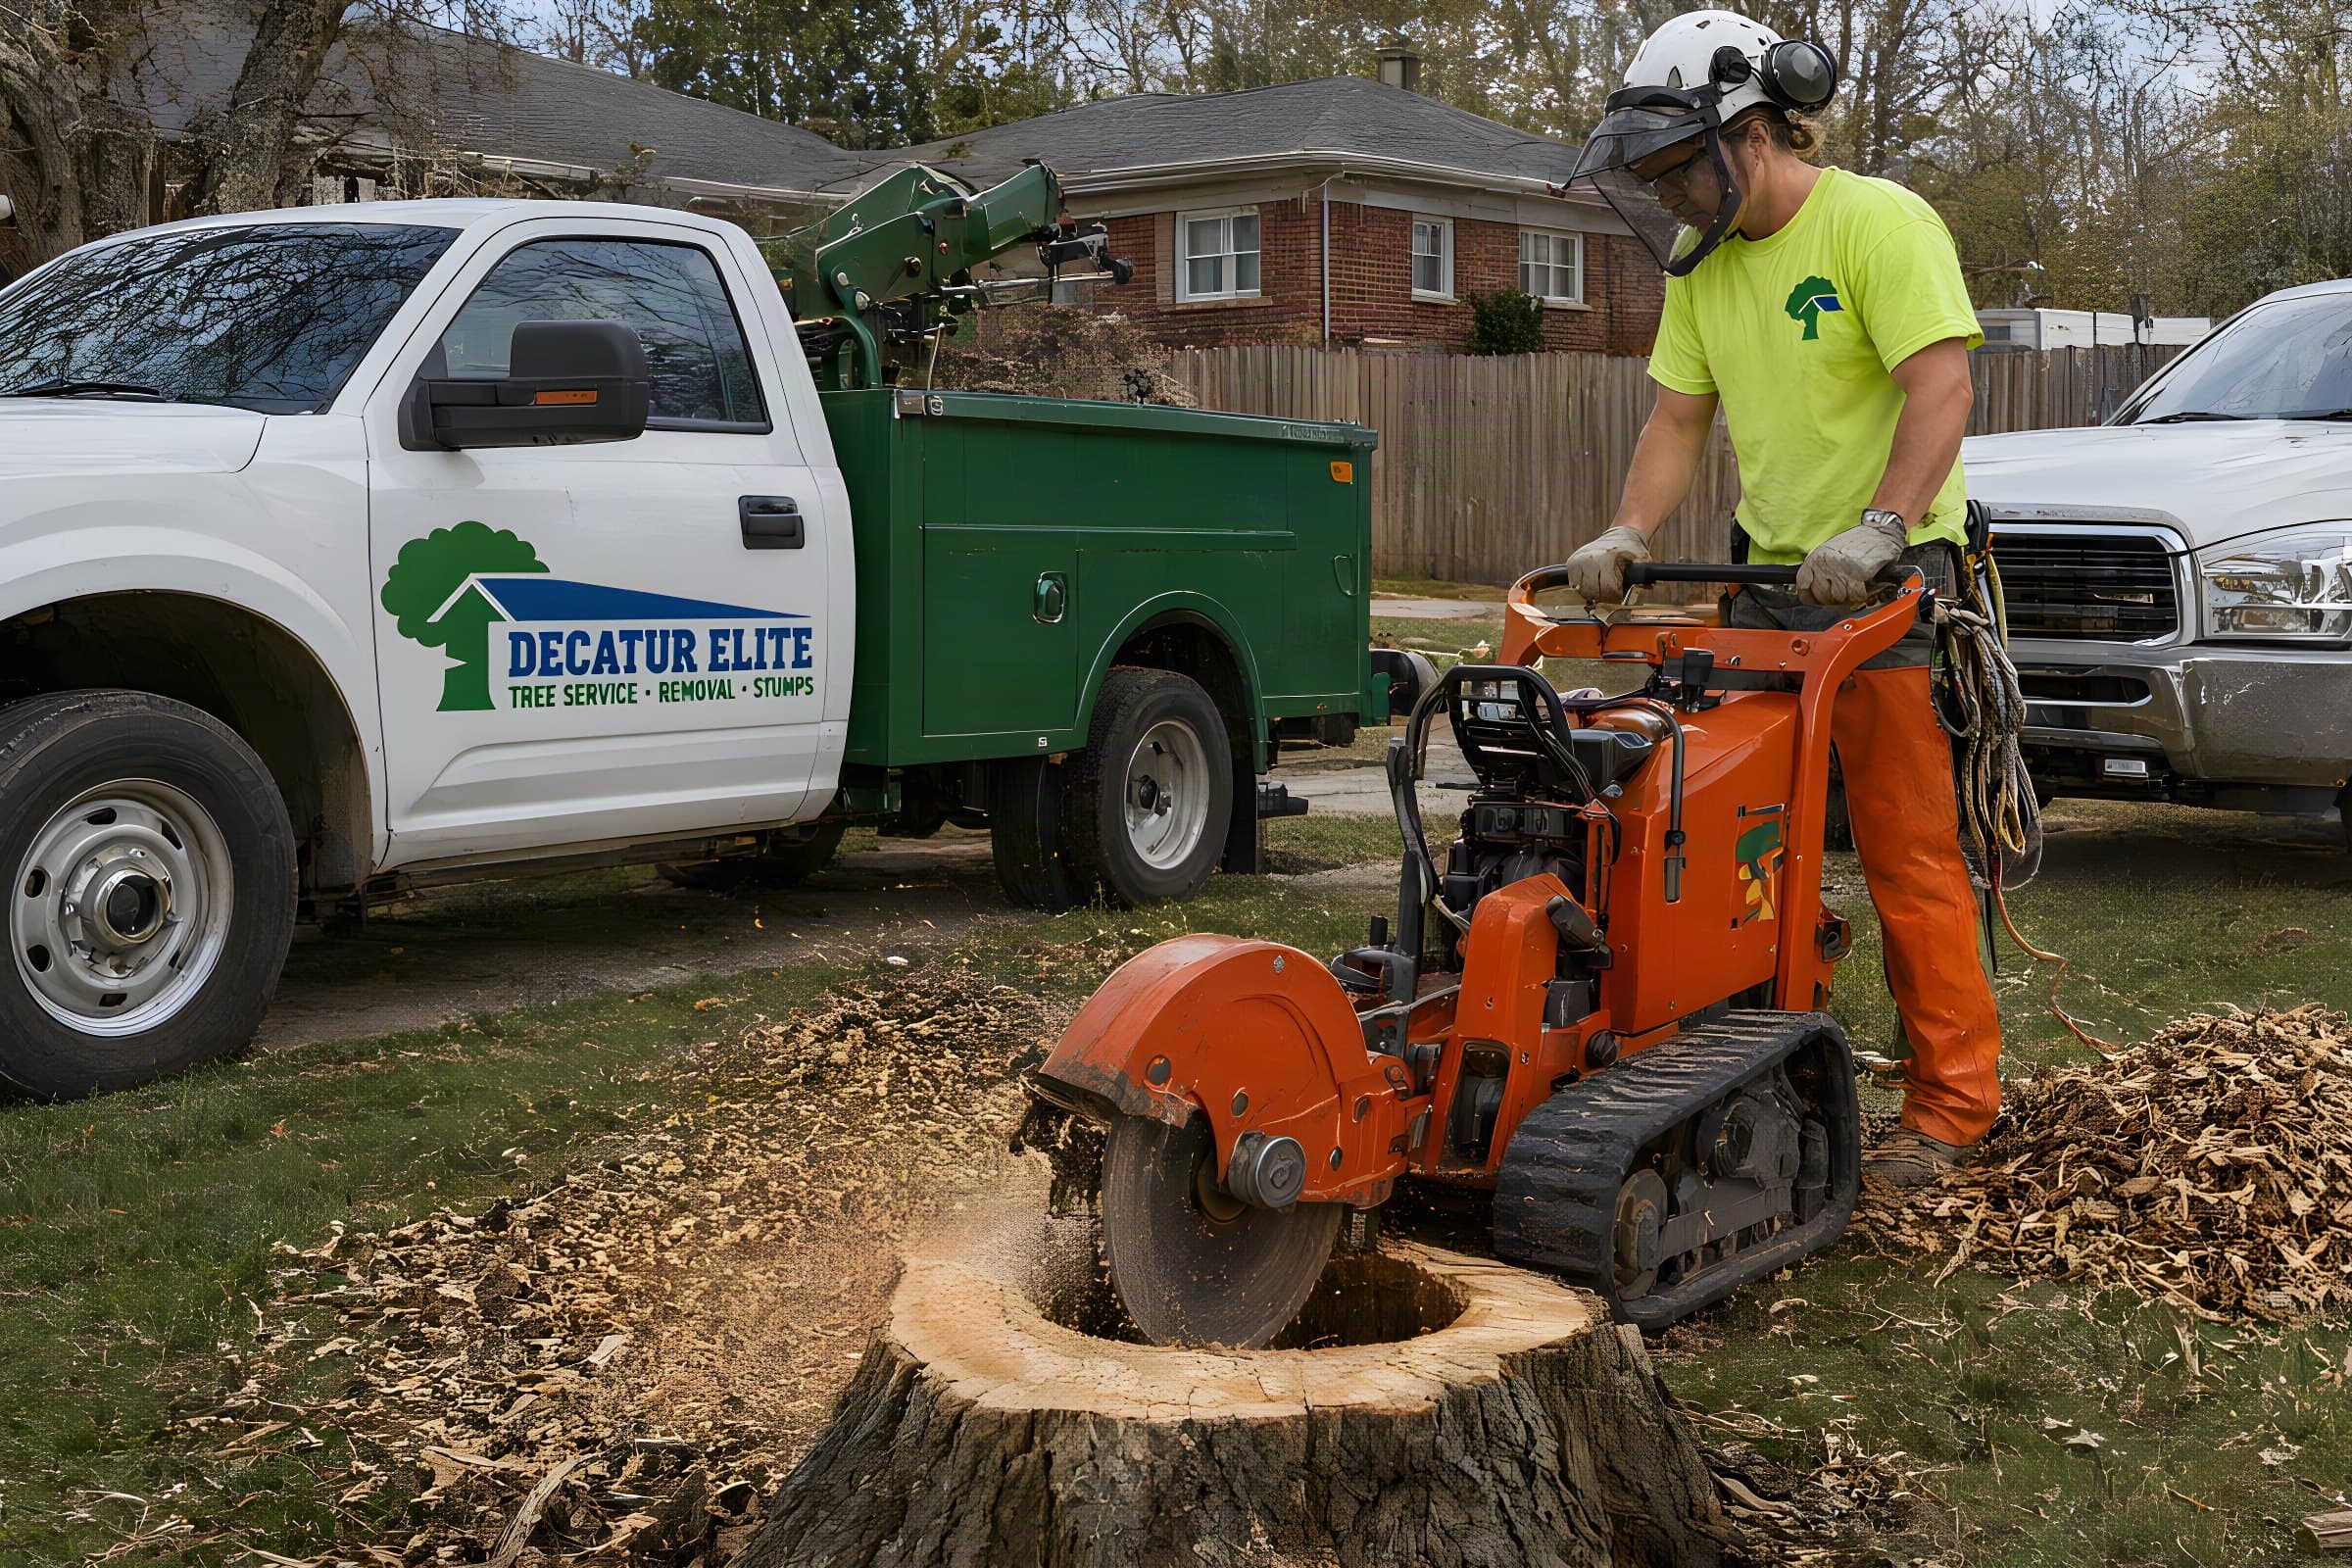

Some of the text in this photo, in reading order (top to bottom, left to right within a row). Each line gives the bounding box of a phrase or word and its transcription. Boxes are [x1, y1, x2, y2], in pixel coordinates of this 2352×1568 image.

[509, 627, 812, 678] DECATUR ELITE
[508, 676, 814, 709] TREE SERVICE REMOVAL STUMPS
